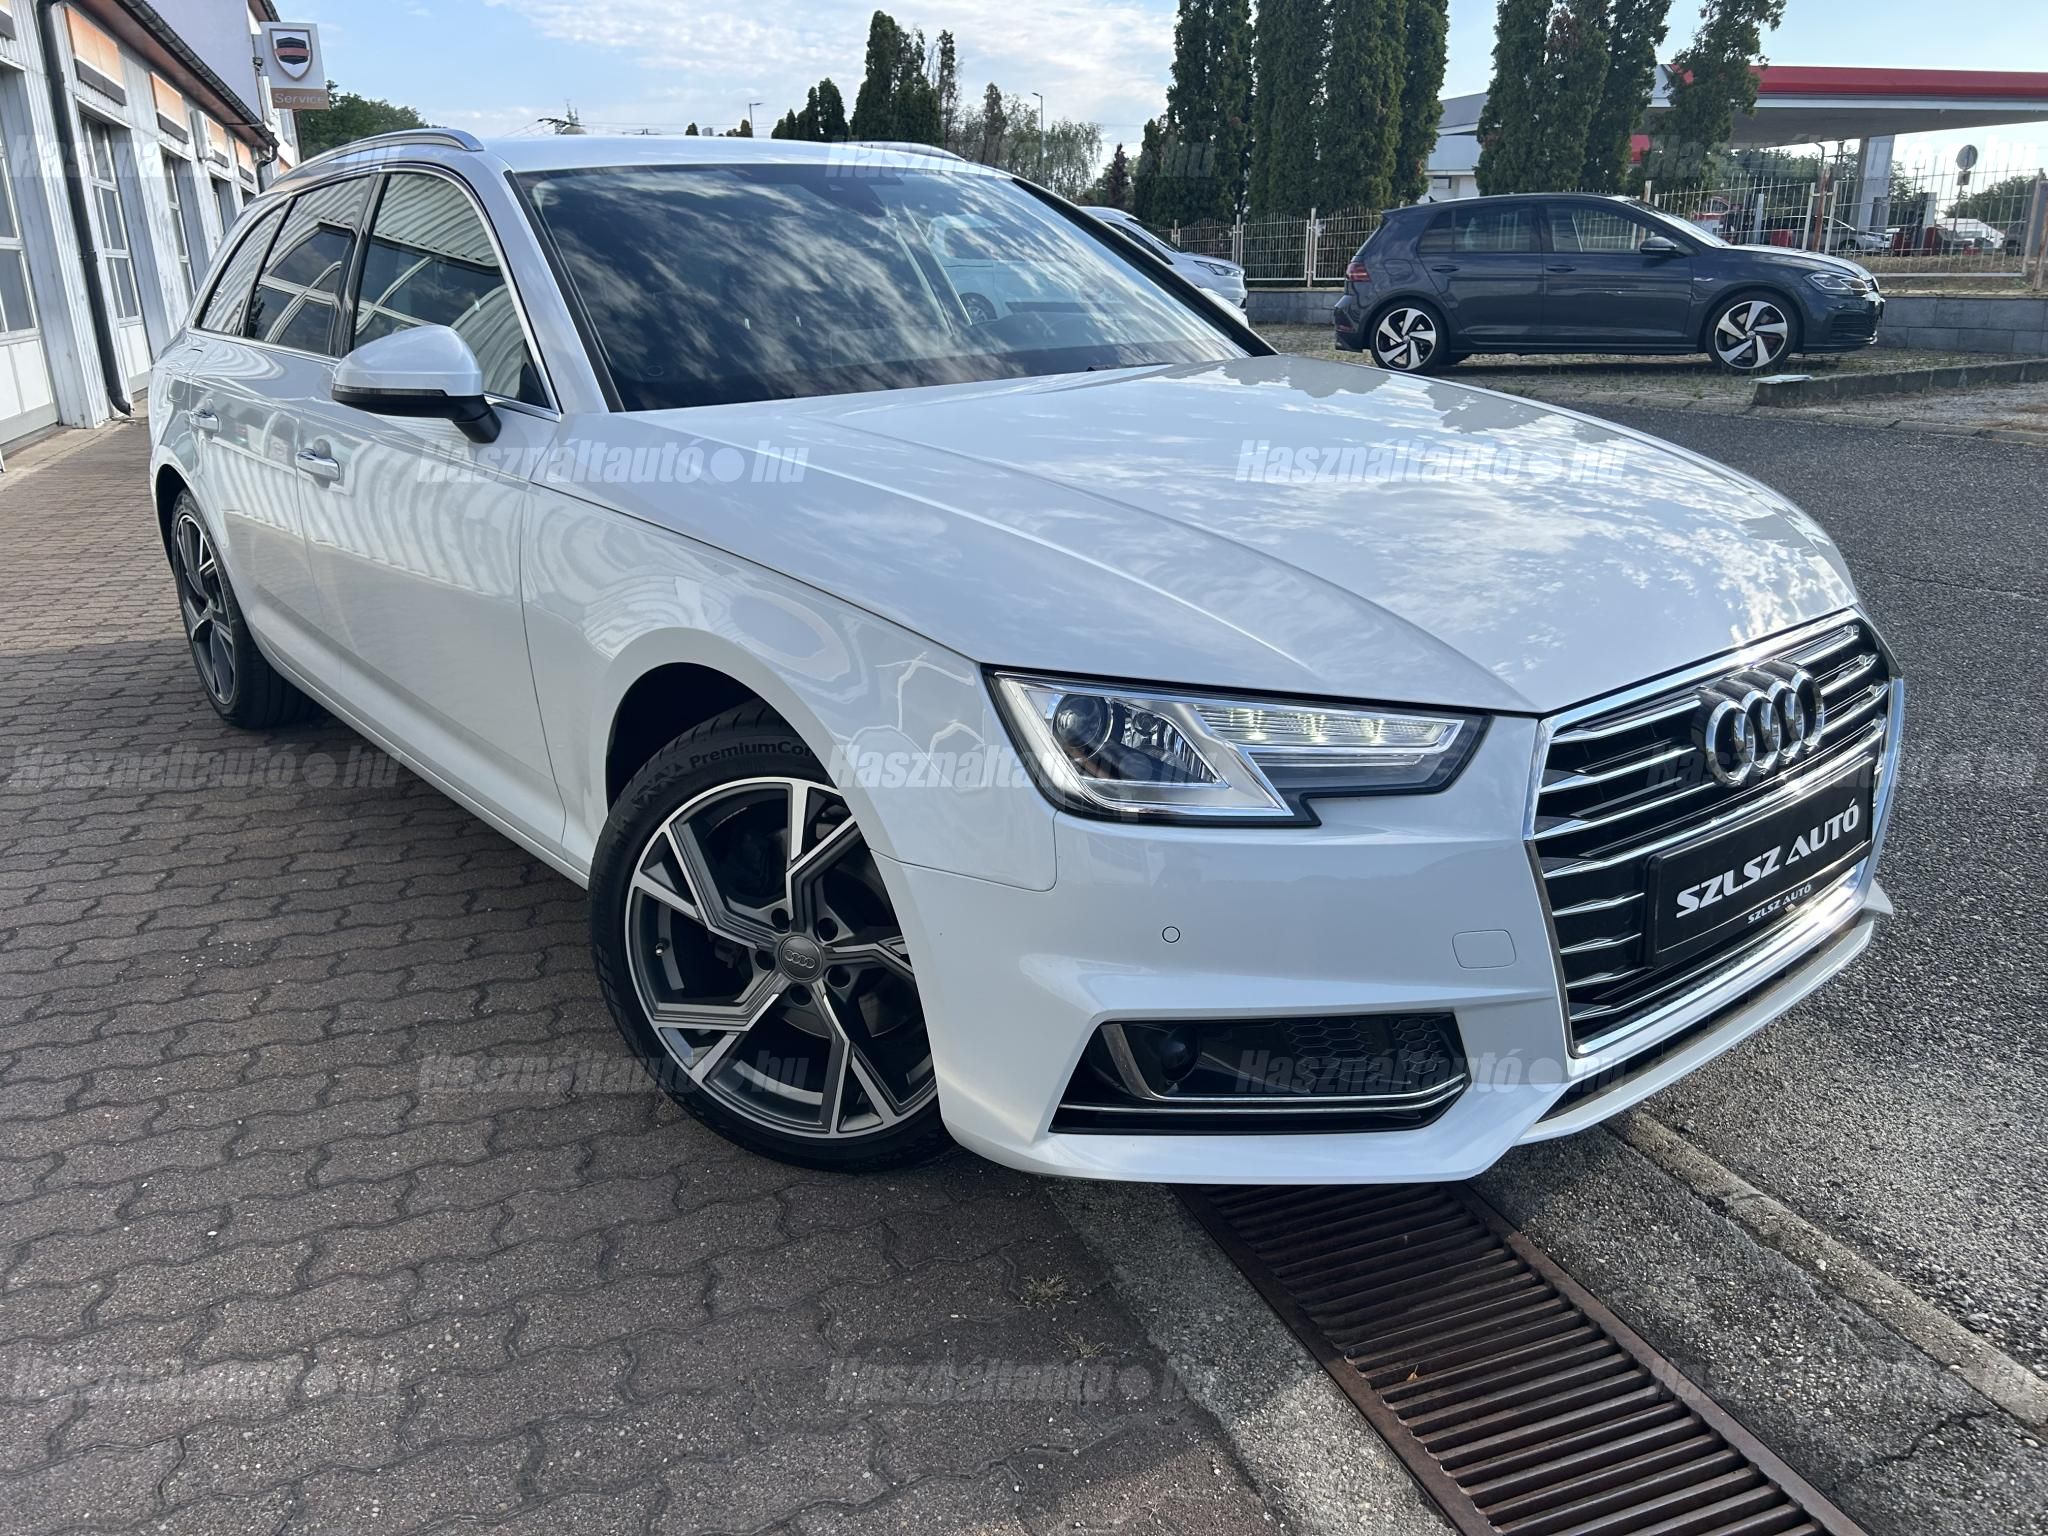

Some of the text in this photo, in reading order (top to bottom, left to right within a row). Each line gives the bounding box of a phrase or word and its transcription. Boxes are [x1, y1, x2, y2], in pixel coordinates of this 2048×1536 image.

[274, 92, 324, 104] Service
[1676, 798, 1859, 918] SZLSZ AUTÓ
[1747, 882, 1812, 924] SZLSZ AUTÓ
